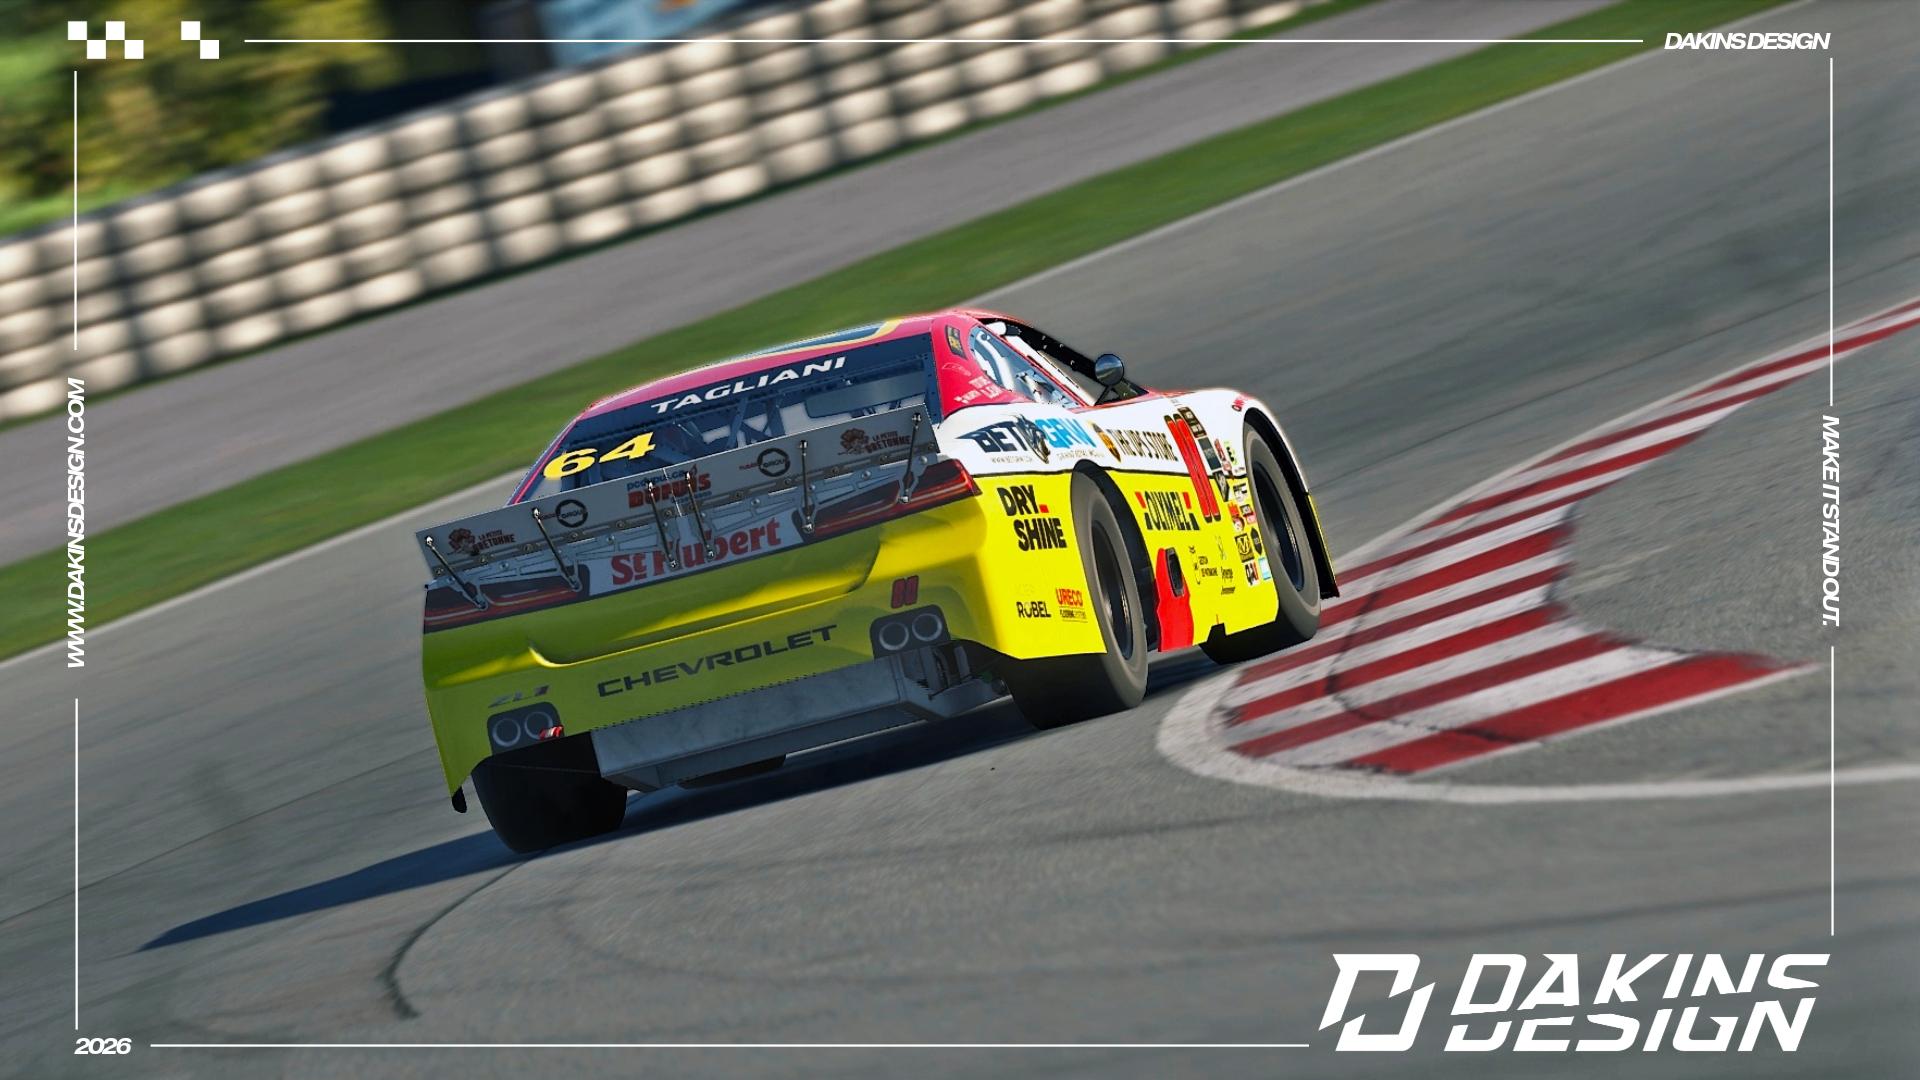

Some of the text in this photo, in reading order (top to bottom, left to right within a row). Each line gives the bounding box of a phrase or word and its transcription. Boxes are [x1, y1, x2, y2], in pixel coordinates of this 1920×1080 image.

[651, 356, 846, 413] TAGLIANI
[543, 432, 656, 480] 64
[1013, 518, 1067, 551] SHINE
[597, 624, 838, 698] CHEVROLET
